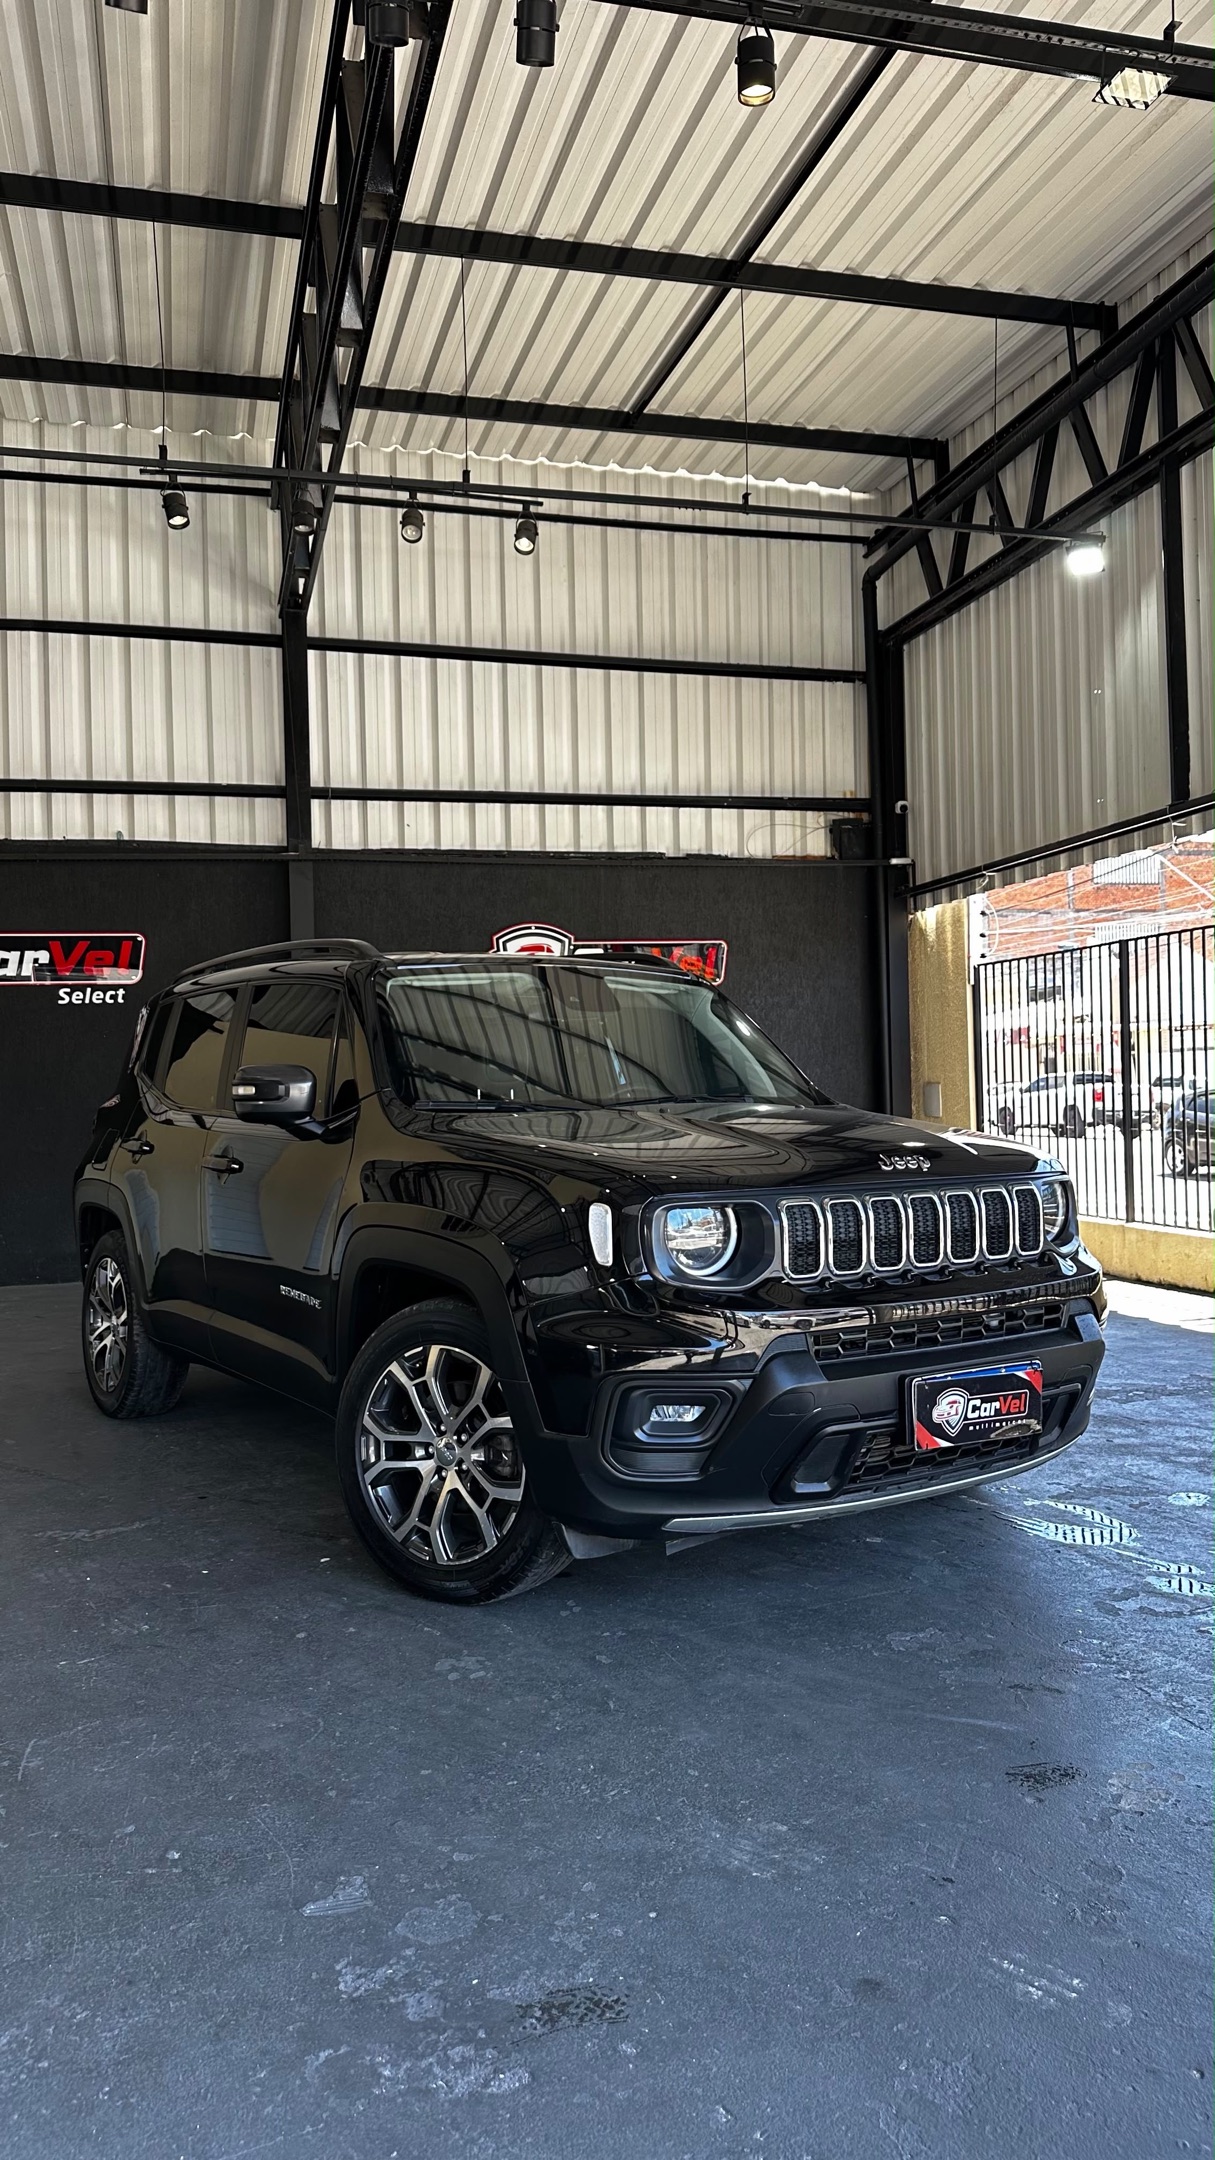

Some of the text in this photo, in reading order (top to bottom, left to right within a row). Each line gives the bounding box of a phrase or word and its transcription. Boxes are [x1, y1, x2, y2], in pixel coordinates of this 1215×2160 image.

[0, 940, 134, 976] arVel
[57, 987, 126, 1005] Select
[878, 1153, 931, 1172] Jeep
[966, 1393, 1026, 1419] CarVel
